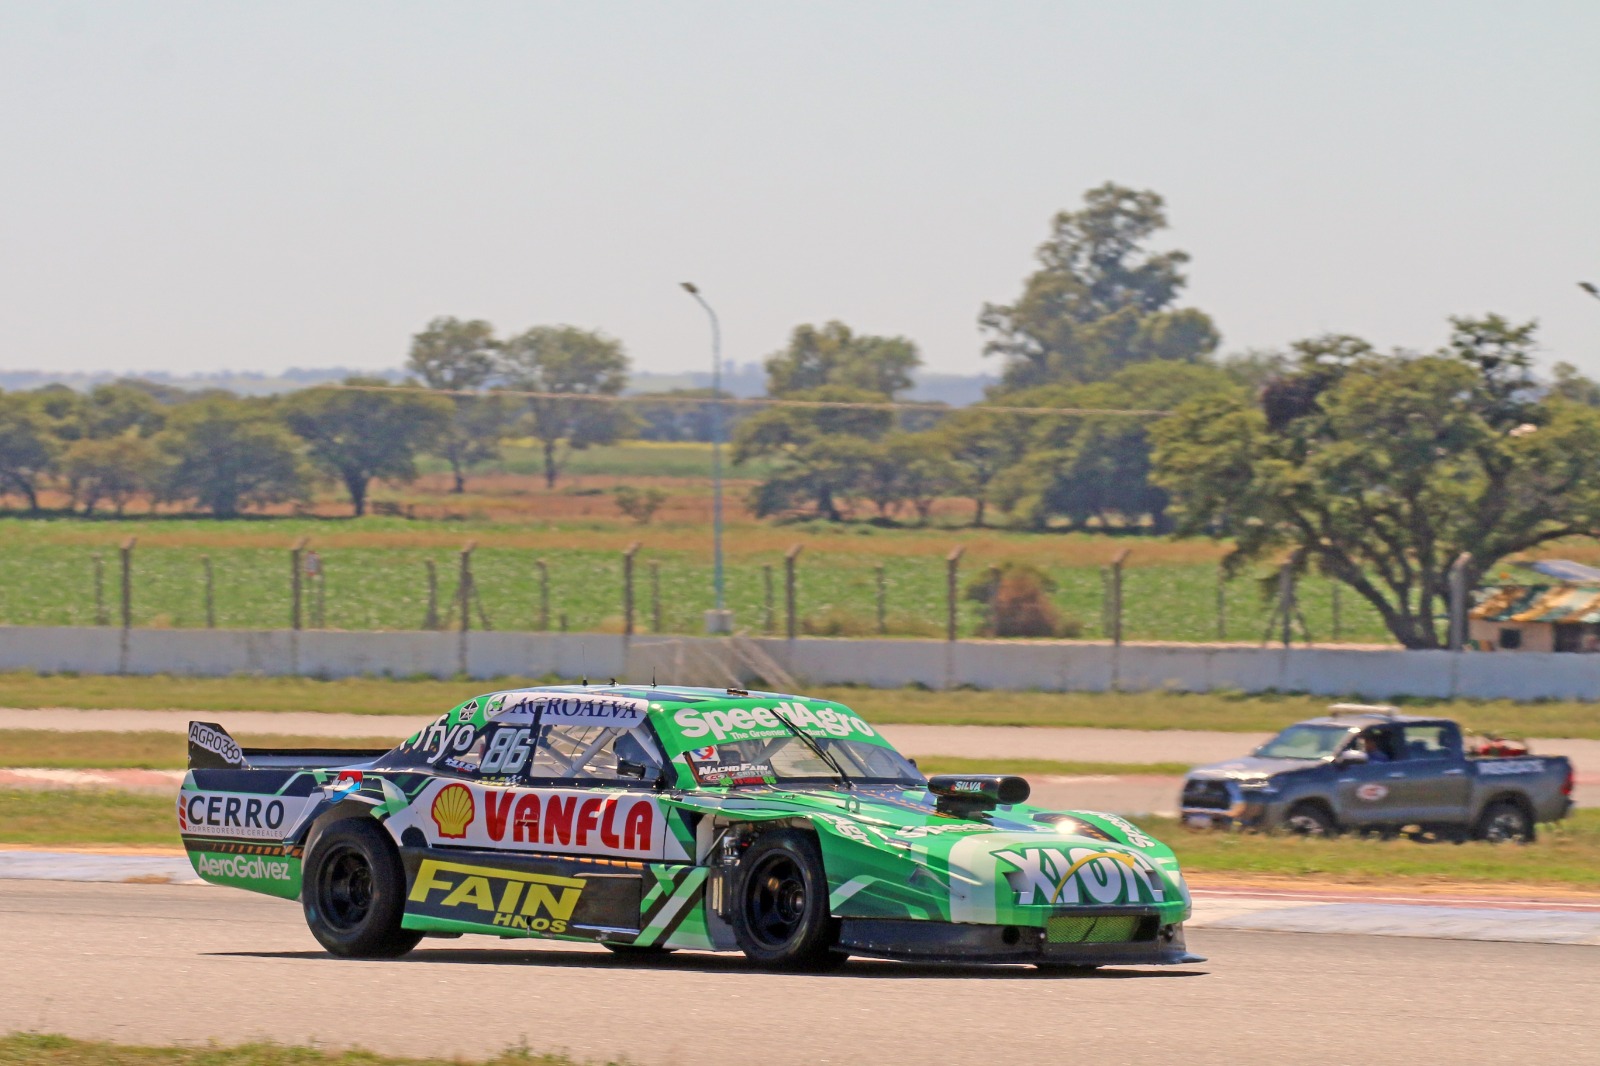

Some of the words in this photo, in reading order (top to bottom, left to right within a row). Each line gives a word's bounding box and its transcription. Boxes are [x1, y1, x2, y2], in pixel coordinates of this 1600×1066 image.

[511, 697, 638, 719] AGROALVA
[191, 725, 241, 760] AGRO360
[730, 732, 749, 740] The
[749, 729, 786, 738] Greener
[479, 728, 532, 774] 86
[954, 780, 982, 792] SILVA
[187, 796, 285, 830] CERRO
[485, 790, 653, 851] VANFLA
[188, 826, 235, 835] CORREDORES
[246, 830, 283, 838] CEREALES
[199, 853, 291, 880] AeroGalvez
[408, 859, 587, 920] FAIN
[492, 912, 569, 933] HNOS
